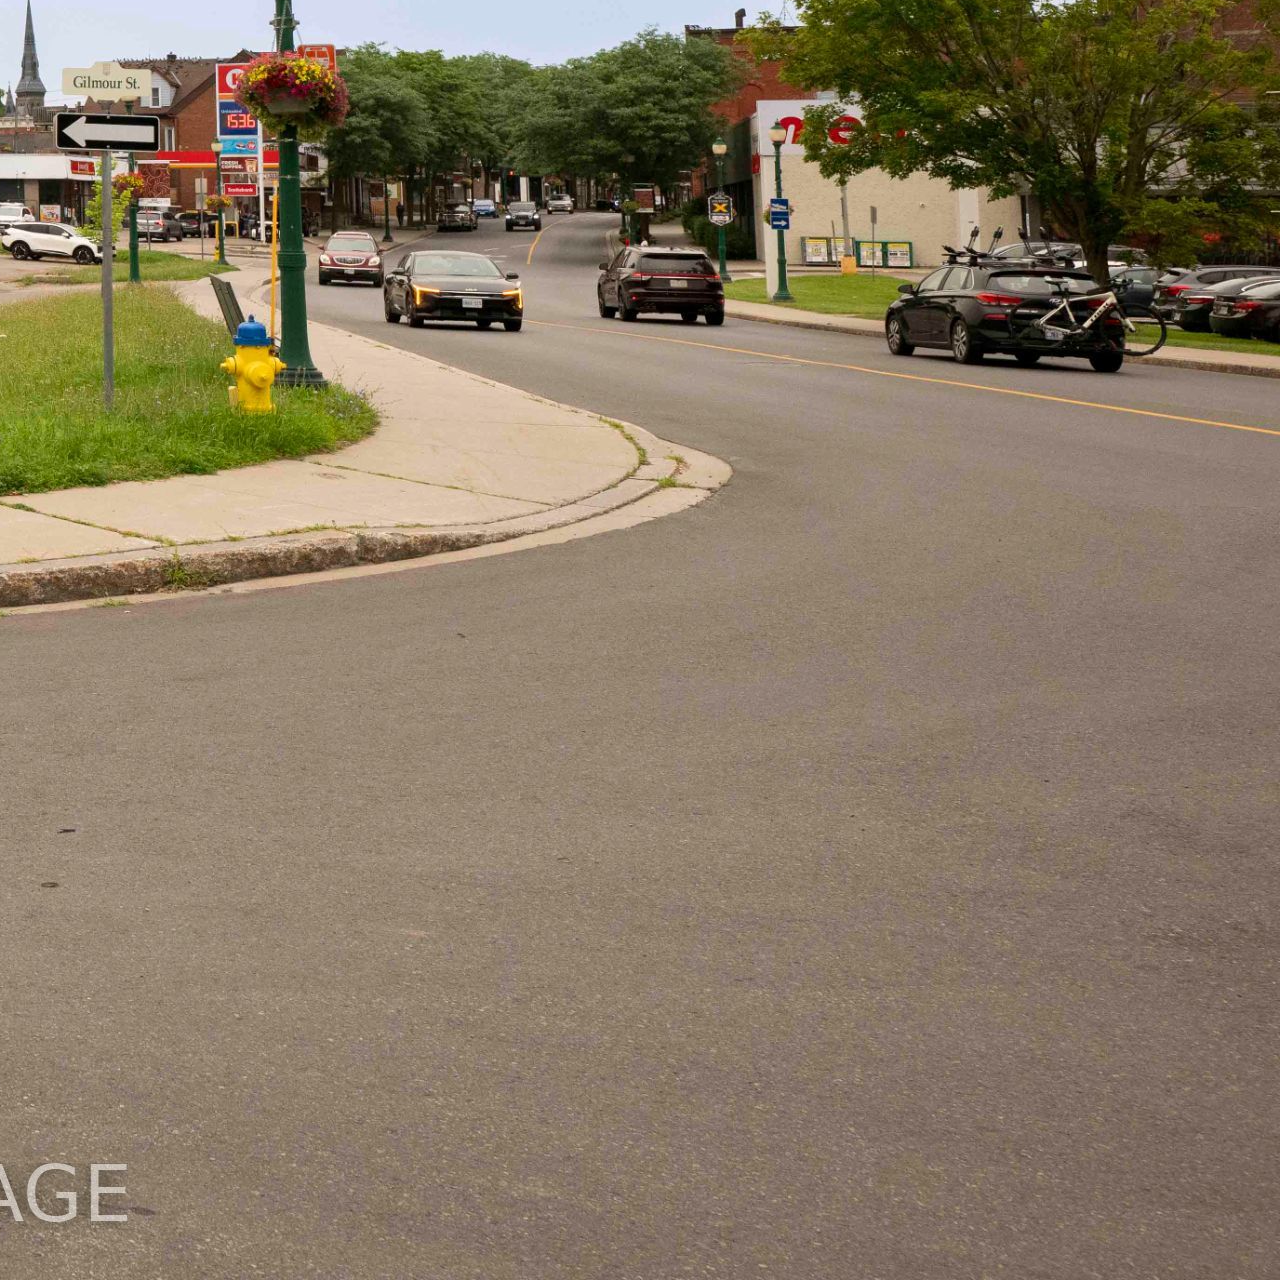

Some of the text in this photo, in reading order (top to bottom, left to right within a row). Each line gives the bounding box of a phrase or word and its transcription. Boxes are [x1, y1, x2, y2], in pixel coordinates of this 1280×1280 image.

[73, 75, 141, 90] Gilmour St.
[227, 186, 254, 194] Scotiabank
